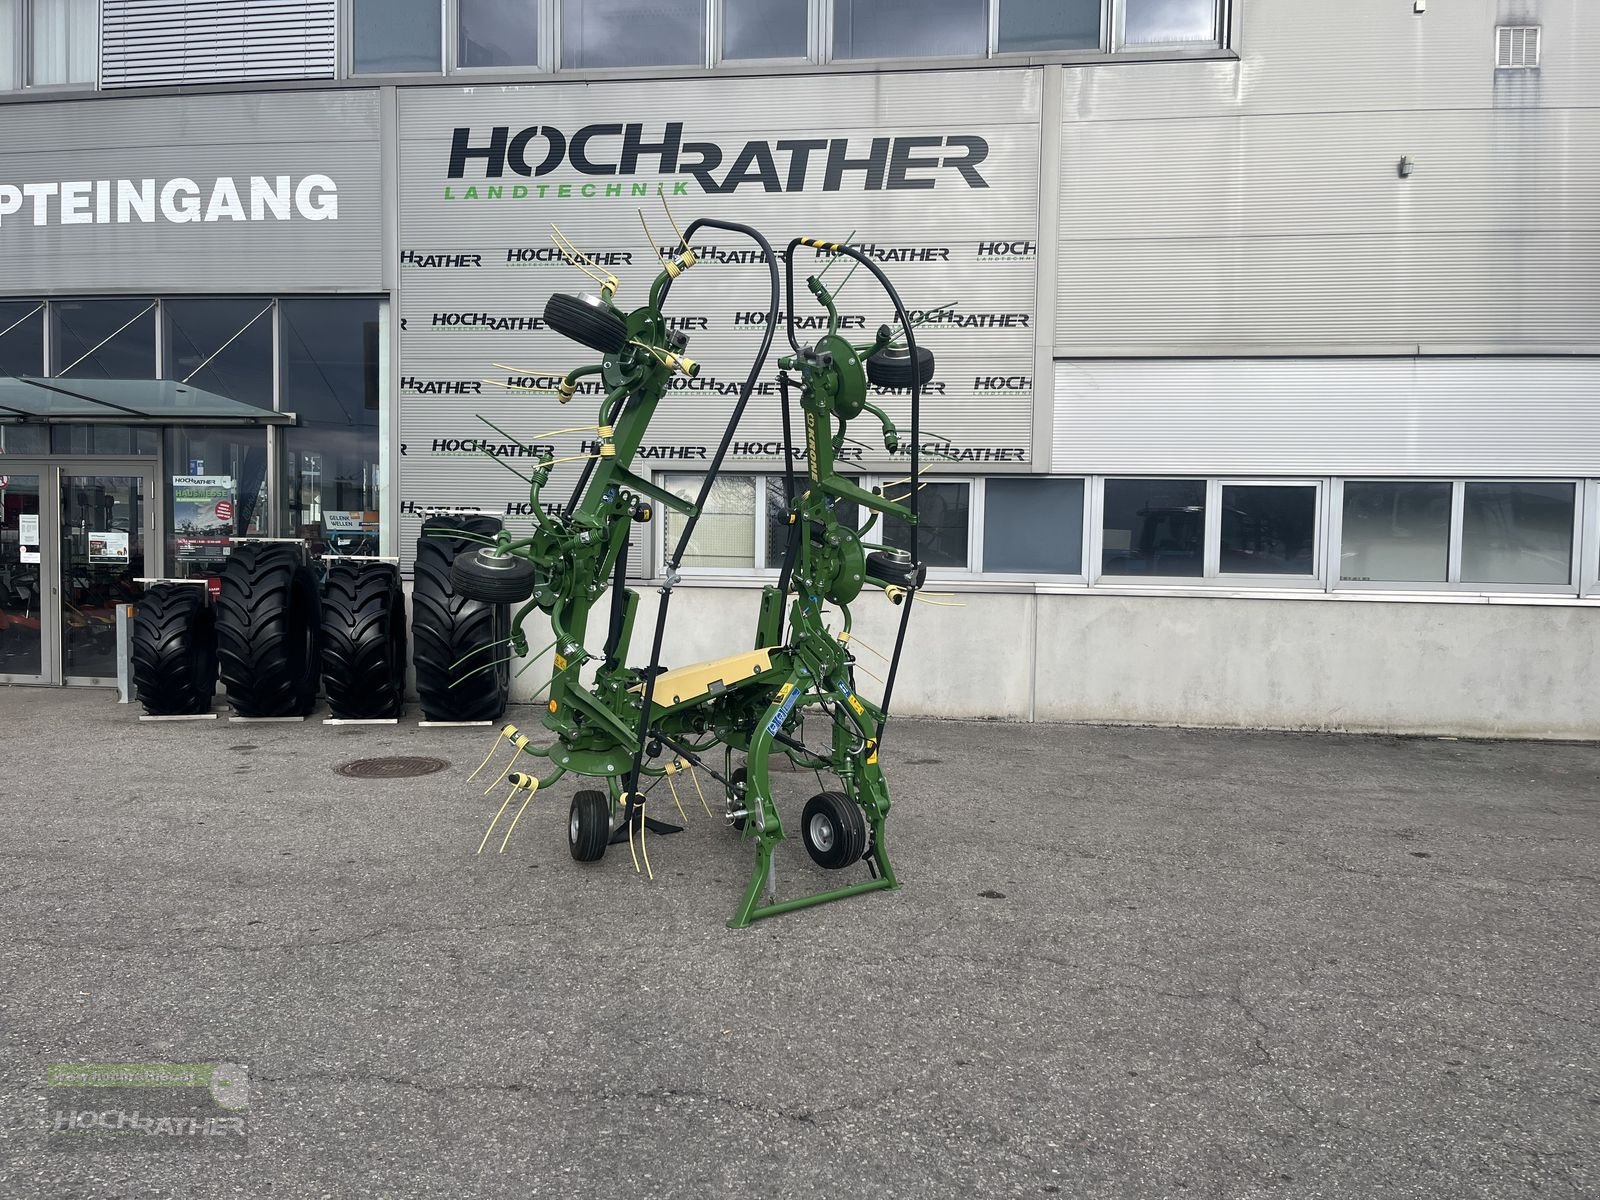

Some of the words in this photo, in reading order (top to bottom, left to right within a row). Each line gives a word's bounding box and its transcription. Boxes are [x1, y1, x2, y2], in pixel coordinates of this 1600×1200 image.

[447, 121, 990, 194] HOCHRATHER
[444, 181, 689, 200] LANDTECHNIK
[507, 248, 633, 266] HOCHRATHER
[432, 313, 547, 331] HOCHRATHE
[807, 427, 819, 482] KRONE
